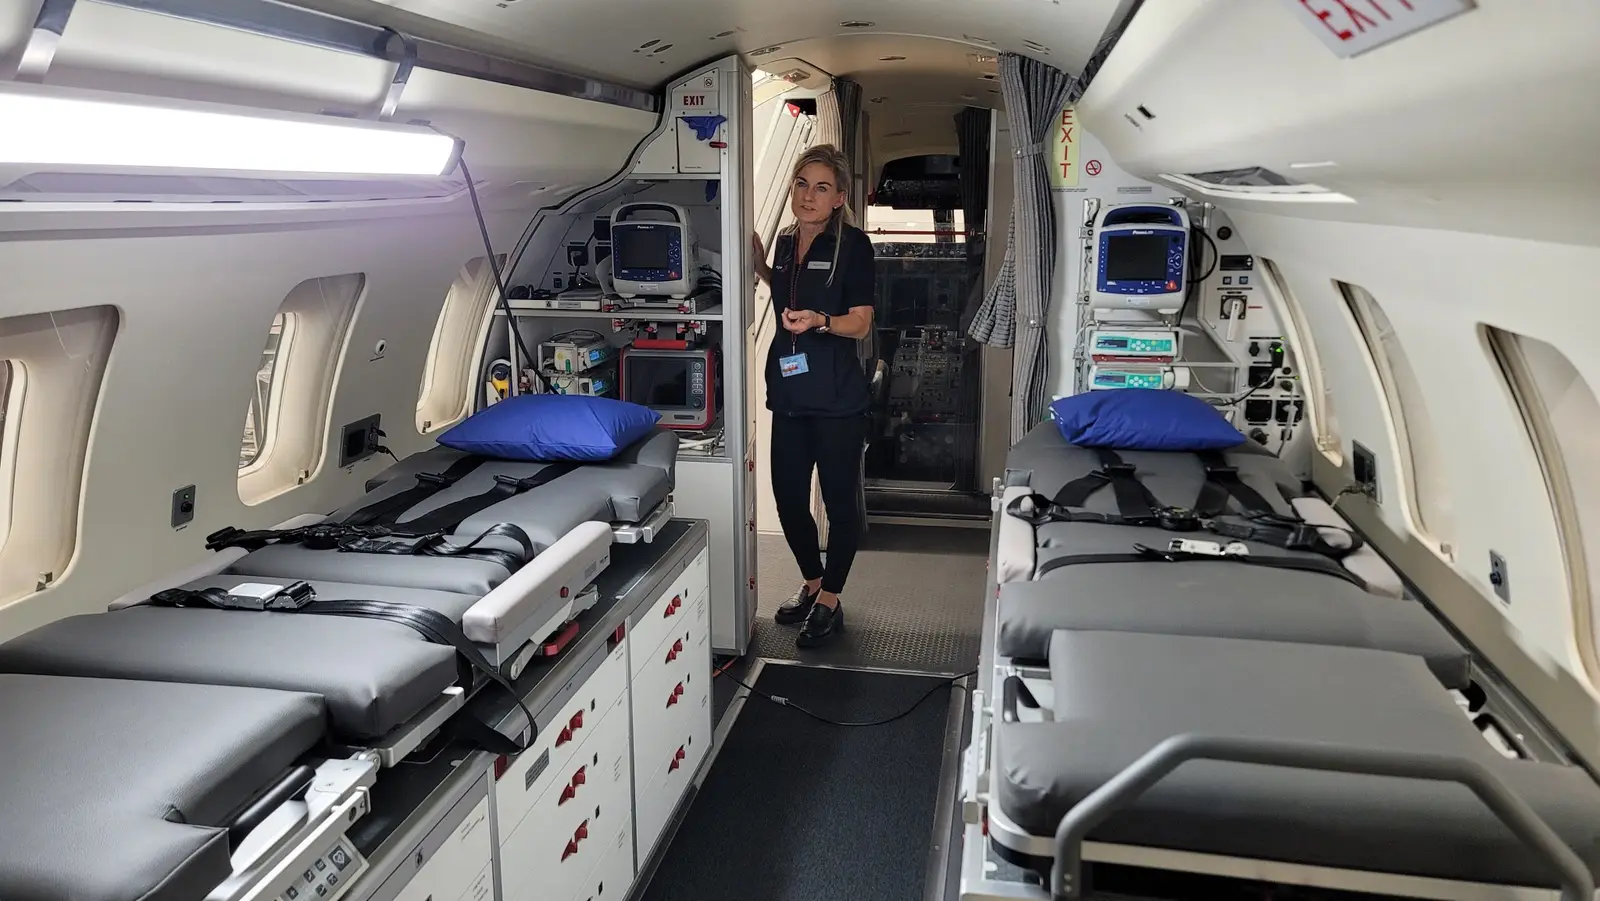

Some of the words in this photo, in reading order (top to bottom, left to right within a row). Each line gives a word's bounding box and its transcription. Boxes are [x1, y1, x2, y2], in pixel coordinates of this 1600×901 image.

[1298, 0, 1415, 40] EX
[683, 95, 705, 106] EXIT
[1060, 109, 1074, 179] EXIT
